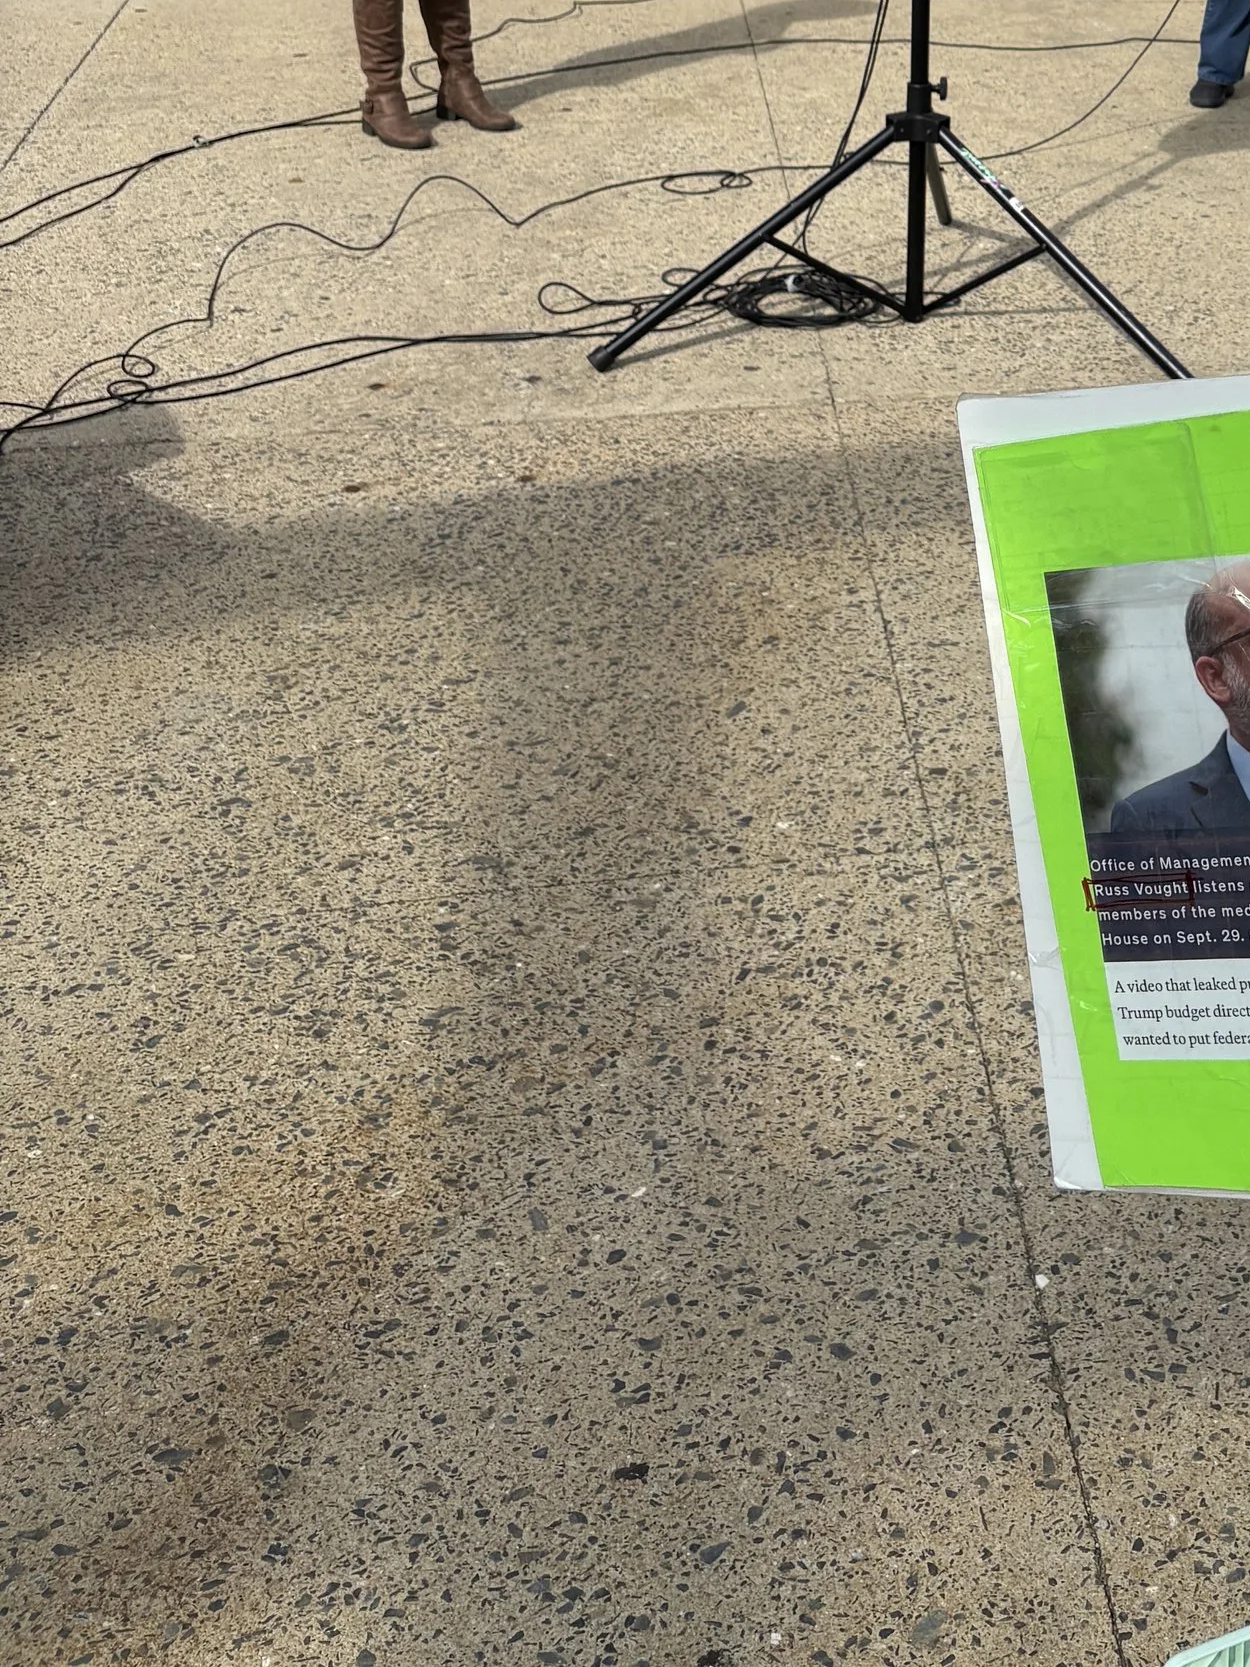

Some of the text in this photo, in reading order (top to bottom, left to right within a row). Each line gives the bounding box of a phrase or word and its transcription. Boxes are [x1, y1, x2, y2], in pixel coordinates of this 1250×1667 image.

[1090, 858, 1135, 872] Office
[1140, 857, 1155, 870] of
[1094, 884, 1130, 897] Russ
[1134, 881, 1189, 898] Vought
[1193, 880, 1245, 893] listens
[1099, 908, 1167, 922] members
[1171, 906, 1187, 919] of
[1191, 905, 1216, 918] the
[1102, 933, 1149, 946] House
[1153, 934, 1172, 945] on
[1176, 930, 1217, 945] Sept.
[1221, 930, 1245, 942] 29.
[1114, 980, 1125, 993] A
[1127, 979, 1163, 992] video
[1165, 978, 1191, 992] that
[1193, 977, 1237, 991] leaked
[1117, 1006, 1163, 1022] Trump
[1165, 1004, 1211, 1021] budget
[1123, 1031, 1171, 1045] wanted
[1173, 1032, 1186, 1045] to
[1189, 1033, 1210, 1048] put
